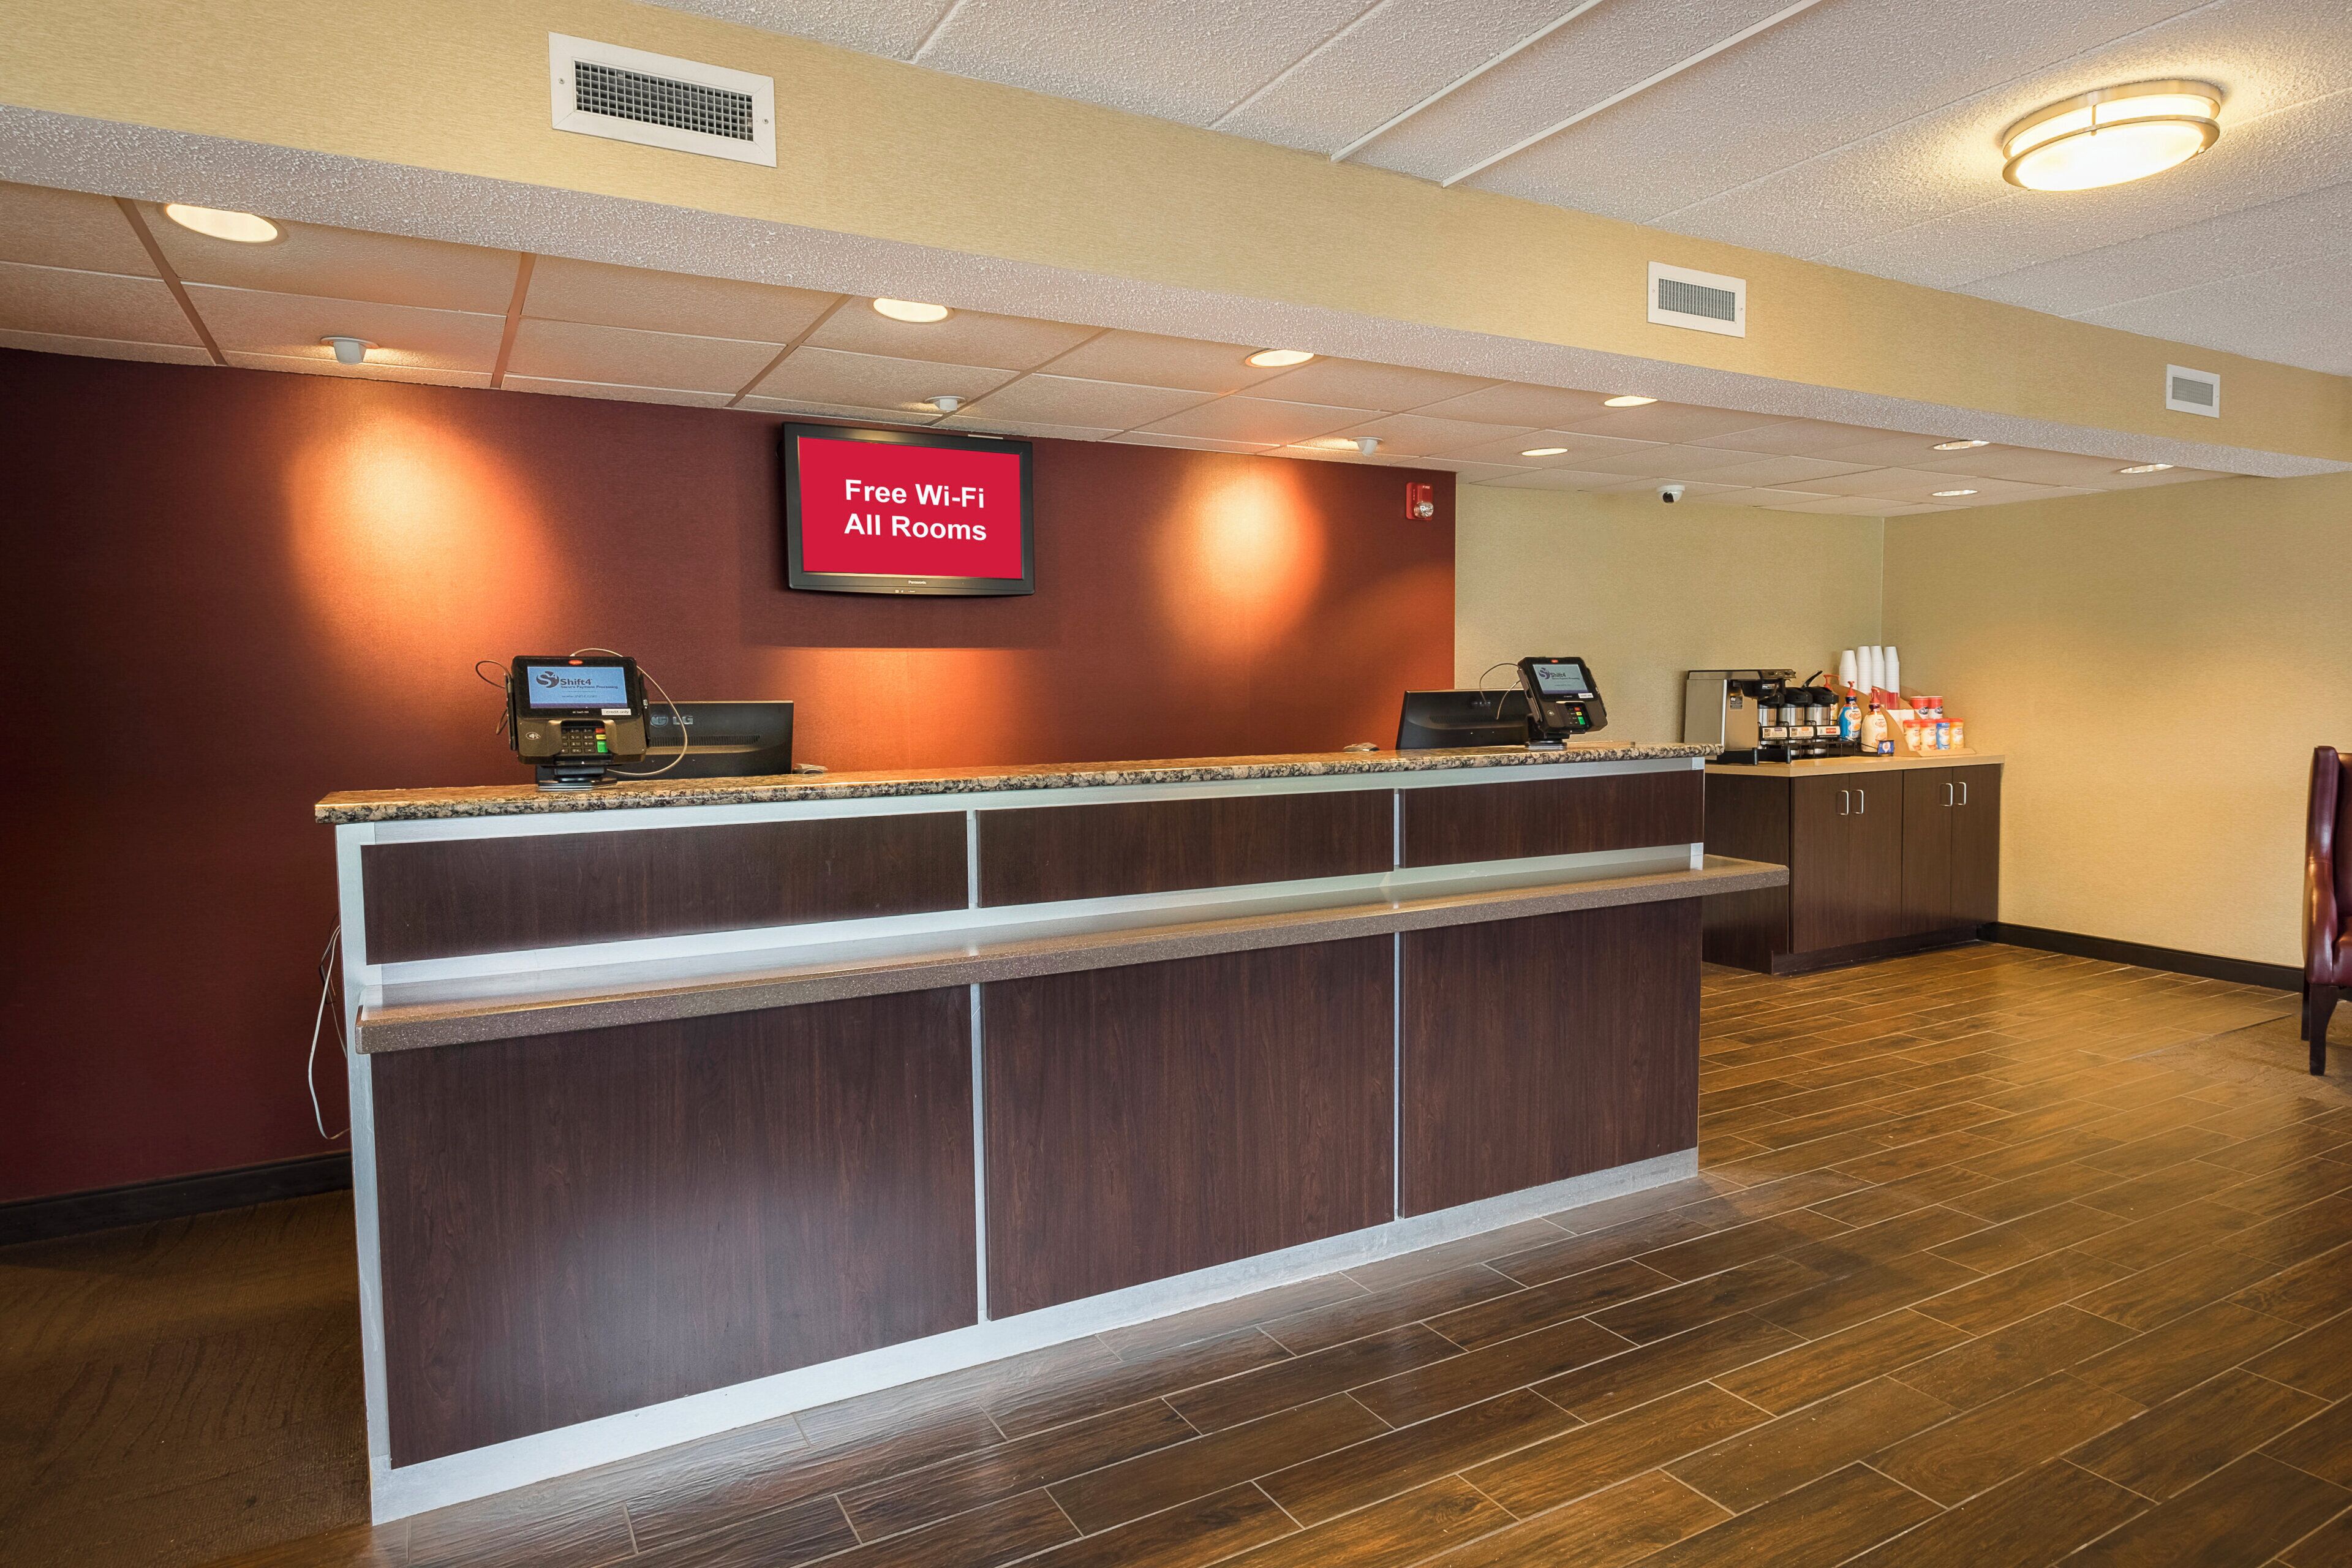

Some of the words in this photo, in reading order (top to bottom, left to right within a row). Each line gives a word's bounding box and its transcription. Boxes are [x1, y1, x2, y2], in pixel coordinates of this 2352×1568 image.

[845, 479, 907, 504] Free
[914, 483, 984, 508] Wi-Fi
[843, 513, 881, 535] All
[892, 515, 987, 541] Rooms
